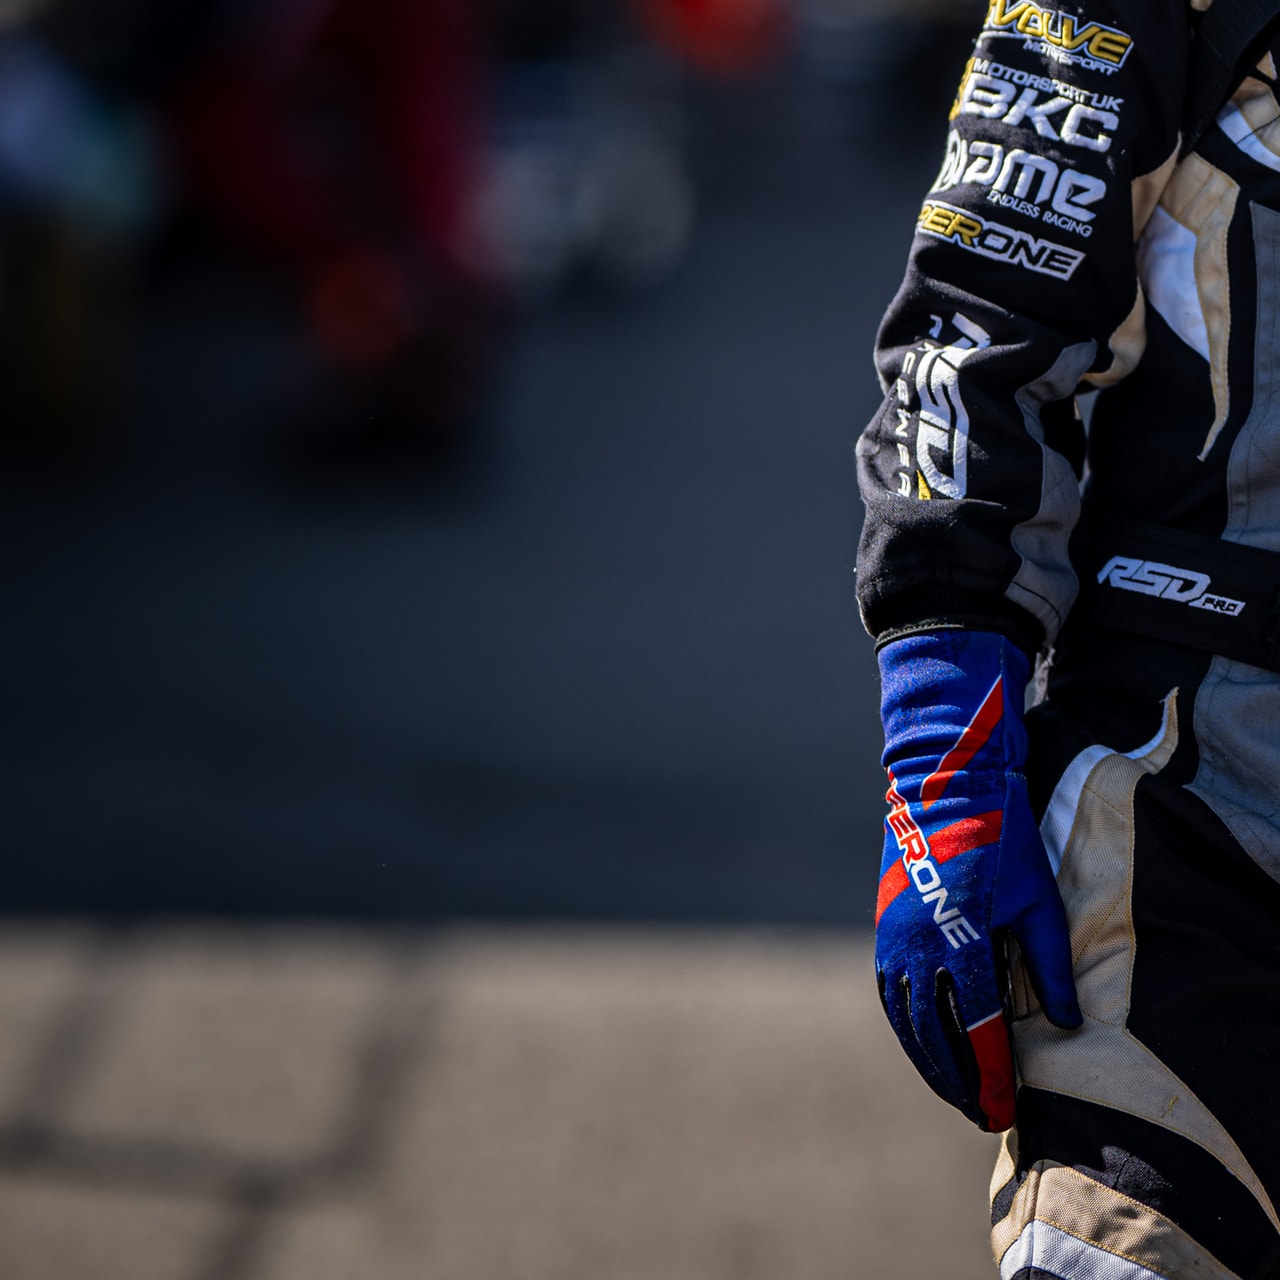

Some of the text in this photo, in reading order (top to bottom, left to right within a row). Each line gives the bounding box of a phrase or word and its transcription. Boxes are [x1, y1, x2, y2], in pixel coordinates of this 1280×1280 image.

[973, 56, 1124, 112] MOTORSPORT UK
[959, 72, 1120, 153] BKC
[986, 189, 1093, 238] ENDLESS RACING
